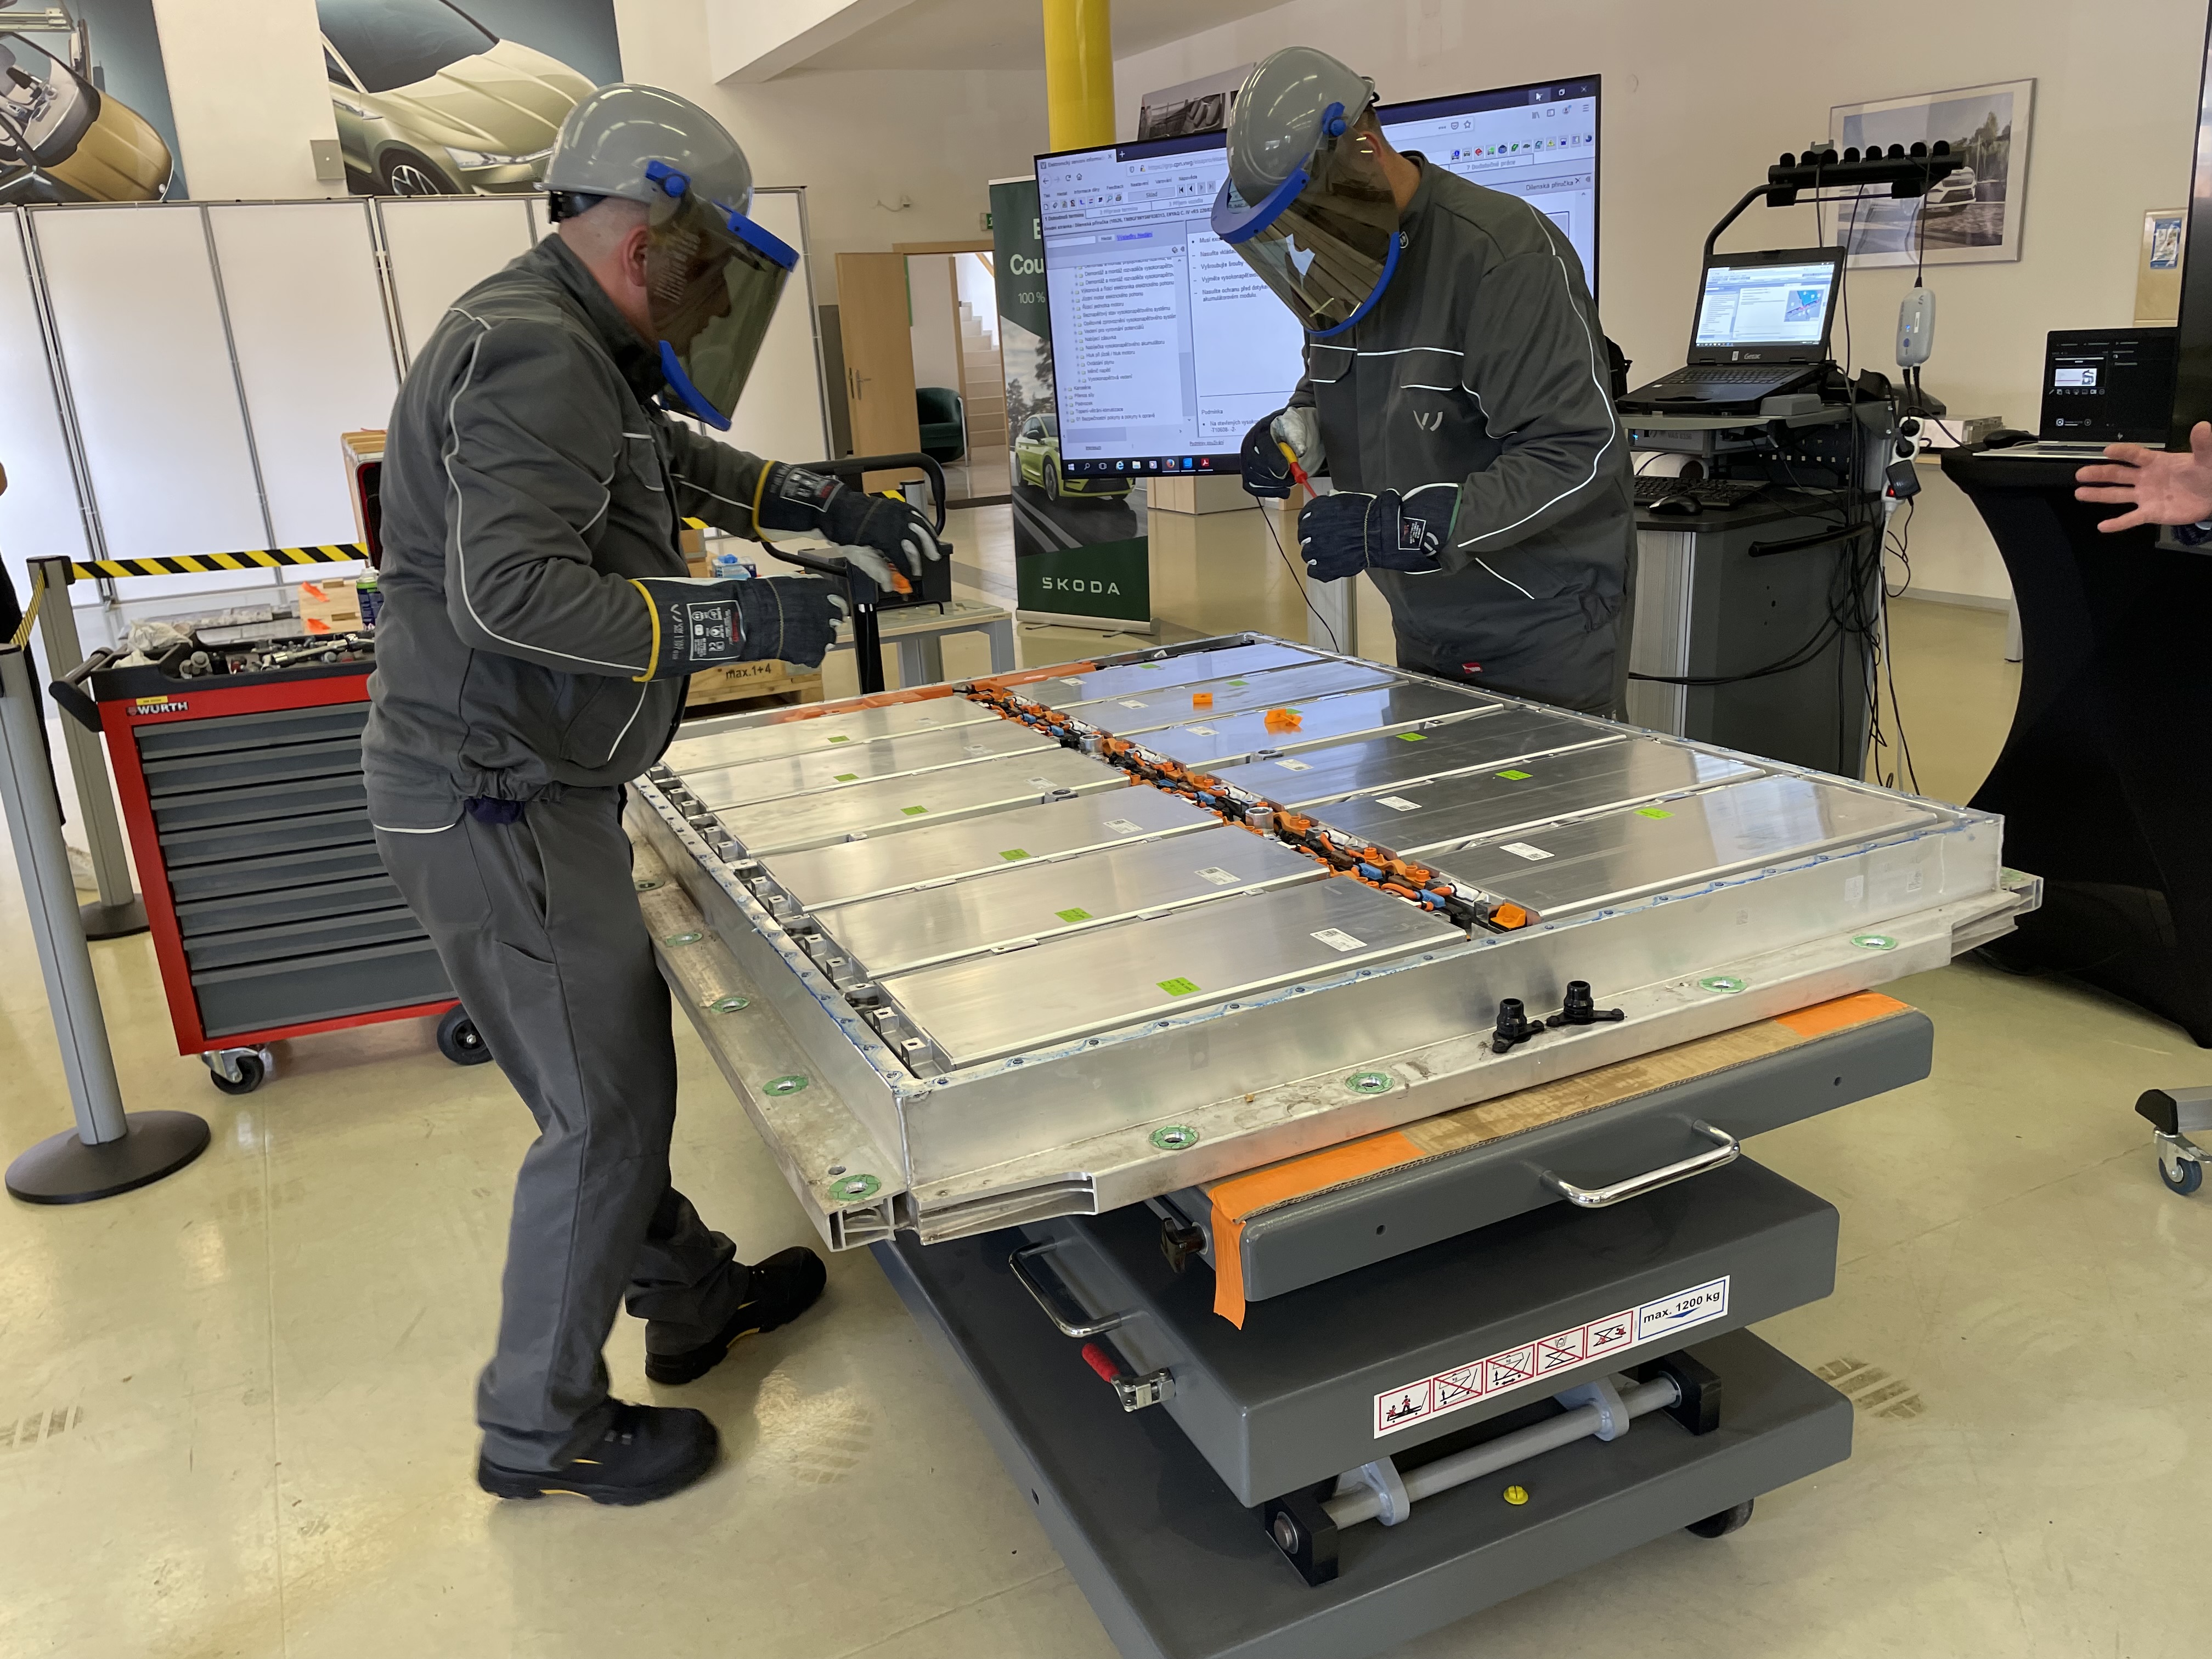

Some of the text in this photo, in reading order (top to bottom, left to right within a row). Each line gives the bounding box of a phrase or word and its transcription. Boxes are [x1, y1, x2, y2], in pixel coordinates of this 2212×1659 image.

[1018, 292, 1045, 303] 100 %
[1644, 1292, 1720, 1323] max. 1200 kg
